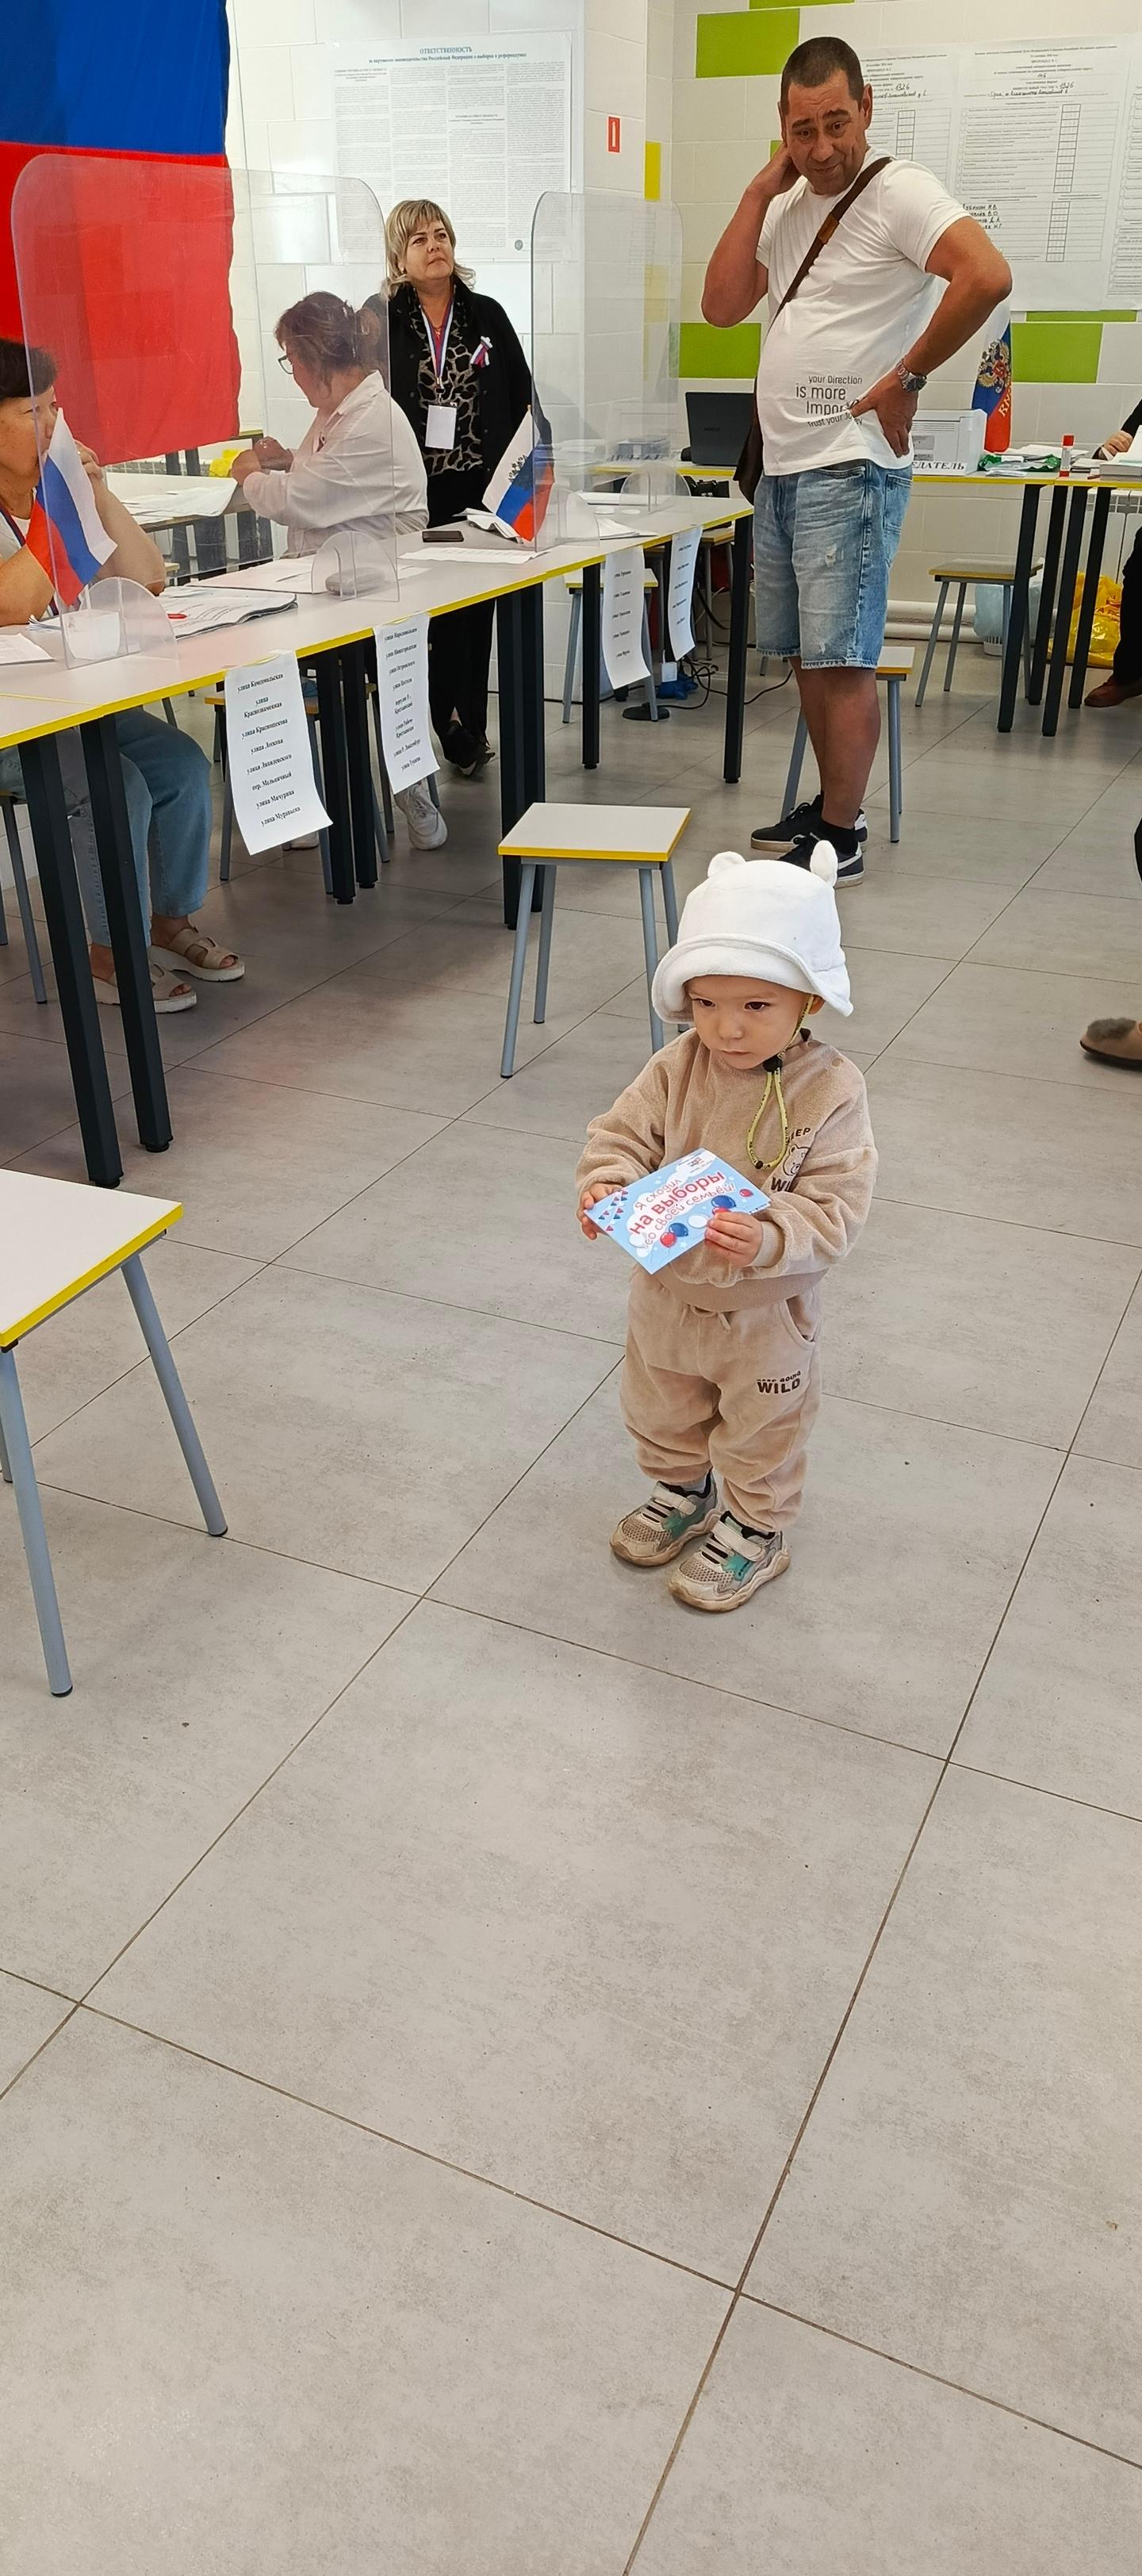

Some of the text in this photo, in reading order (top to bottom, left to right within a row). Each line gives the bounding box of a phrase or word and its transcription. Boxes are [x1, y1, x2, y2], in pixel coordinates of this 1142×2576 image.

[420, 46, 473, 55] ОТВЕТСТВЕННОСТЬ
[808, 375, 863, 384] your Direction
[795, 382, 846, 401] is more
[826, 413, 842, 425] your
[912, 461, 965, 470] ЕДАТЕЛЬ
[634, 1179, 683, 1211] Я сходил
[629, 1171, 725, 1235] на выборы
[757, 1378, 801, 1394] WILD
